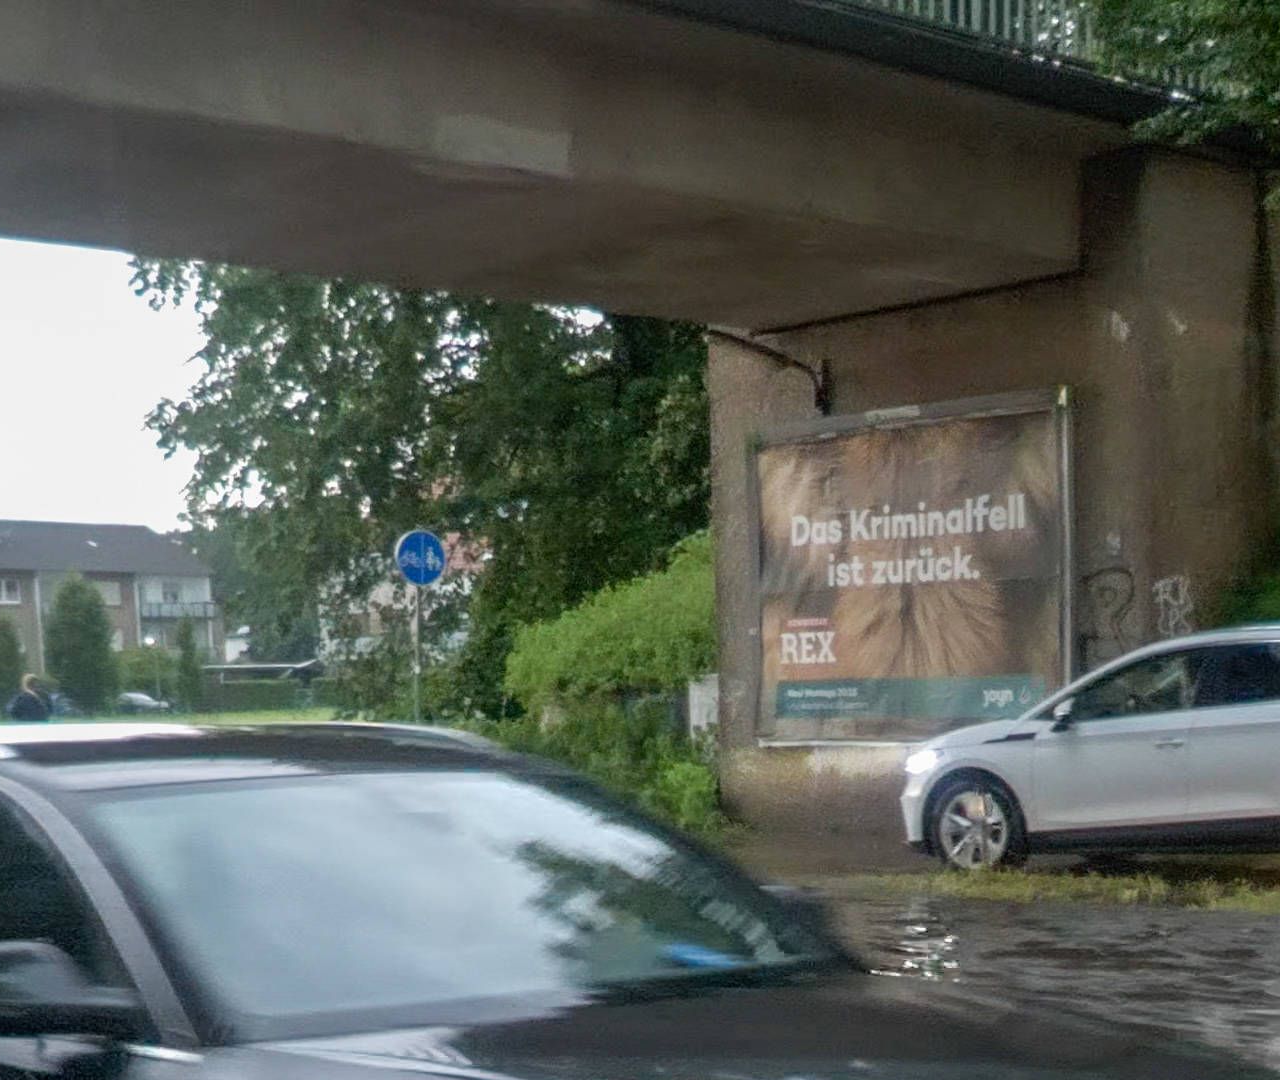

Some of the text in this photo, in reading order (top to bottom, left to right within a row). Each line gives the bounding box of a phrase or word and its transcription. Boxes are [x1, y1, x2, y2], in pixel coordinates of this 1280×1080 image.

[790, 493, 1026, 547] Das Kriminalfell
[828, 546, 982, 587] ist zurück.
[780, 630, 837, 665] REX
